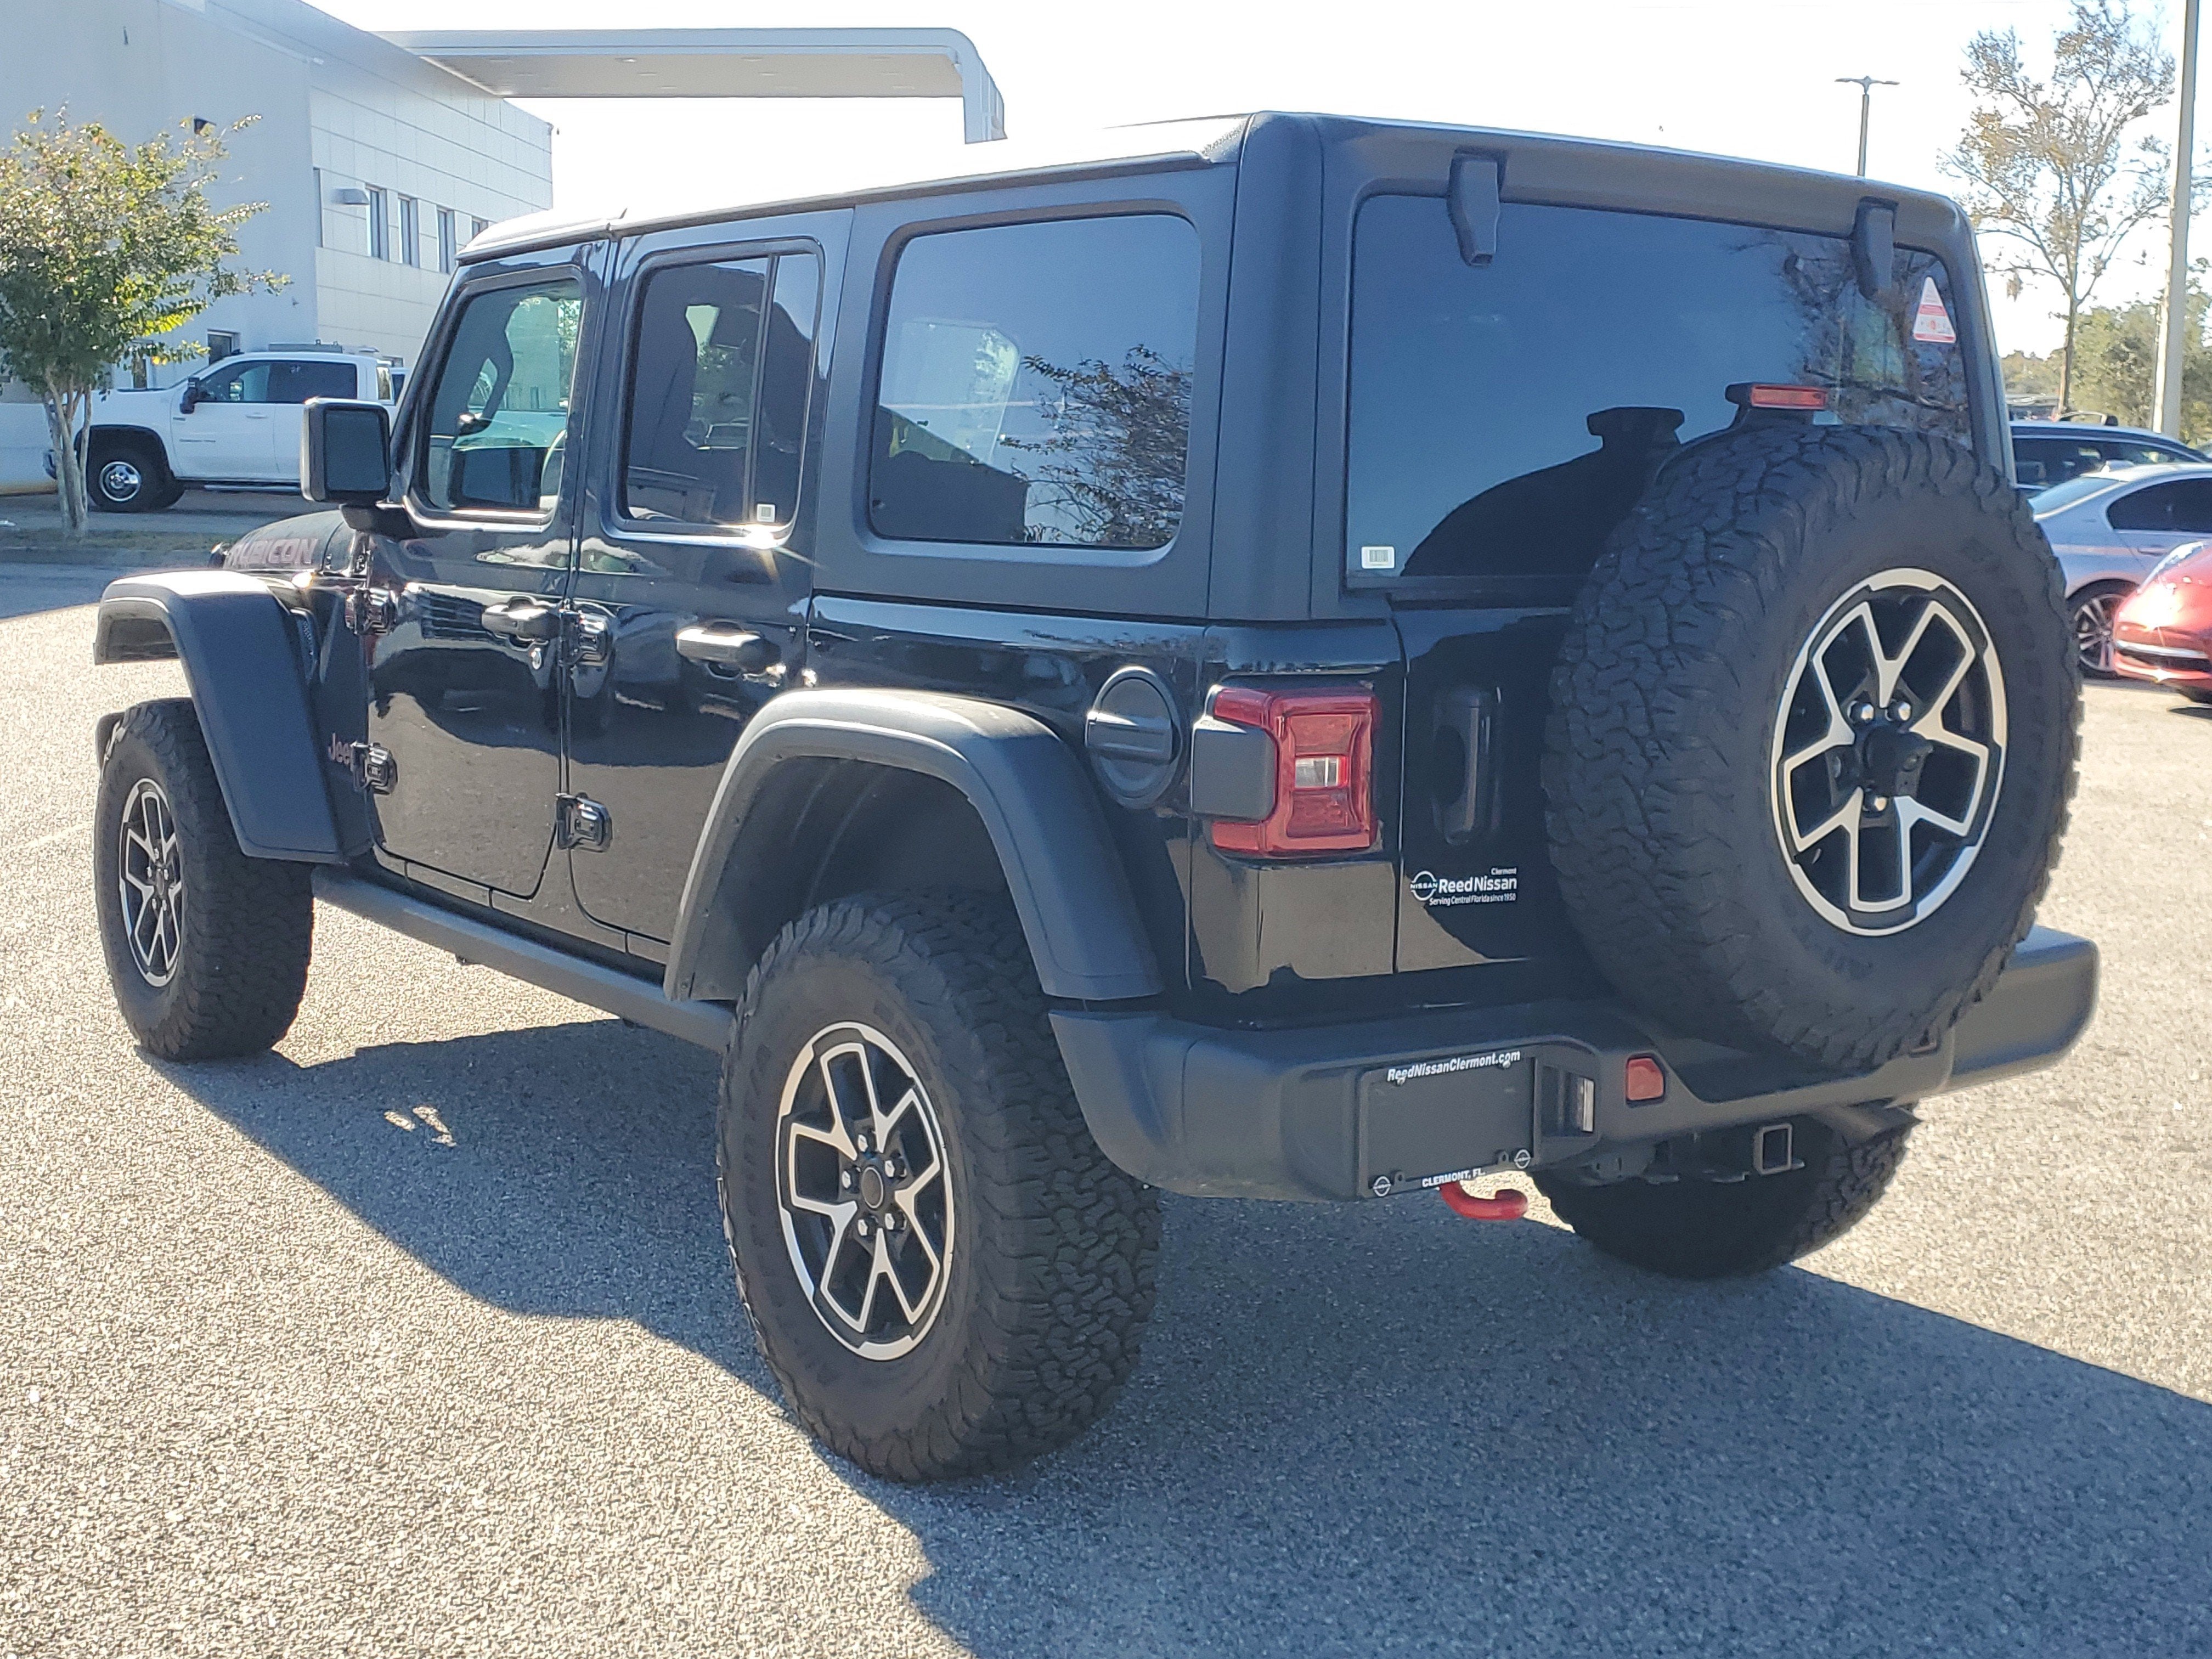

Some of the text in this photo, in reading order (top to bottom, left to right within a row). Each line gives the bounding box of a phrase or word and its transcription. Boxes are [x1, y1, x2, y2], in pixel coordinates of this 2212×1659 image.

[224, 538, 318, 569] RUBICON
[328, 733, 353, 768] Jee
[1429, 898, 1451, 906] Serving
[1451, 895, 1471, 905] Central
[1471, 894, 1489, 903] Florida
[1490, 894, 1504, 902] since
[1387, 1051, 1521, 1082] ReedNissanClermont.com
[1422, 1170, 1471, 1187] CLERMONT,
